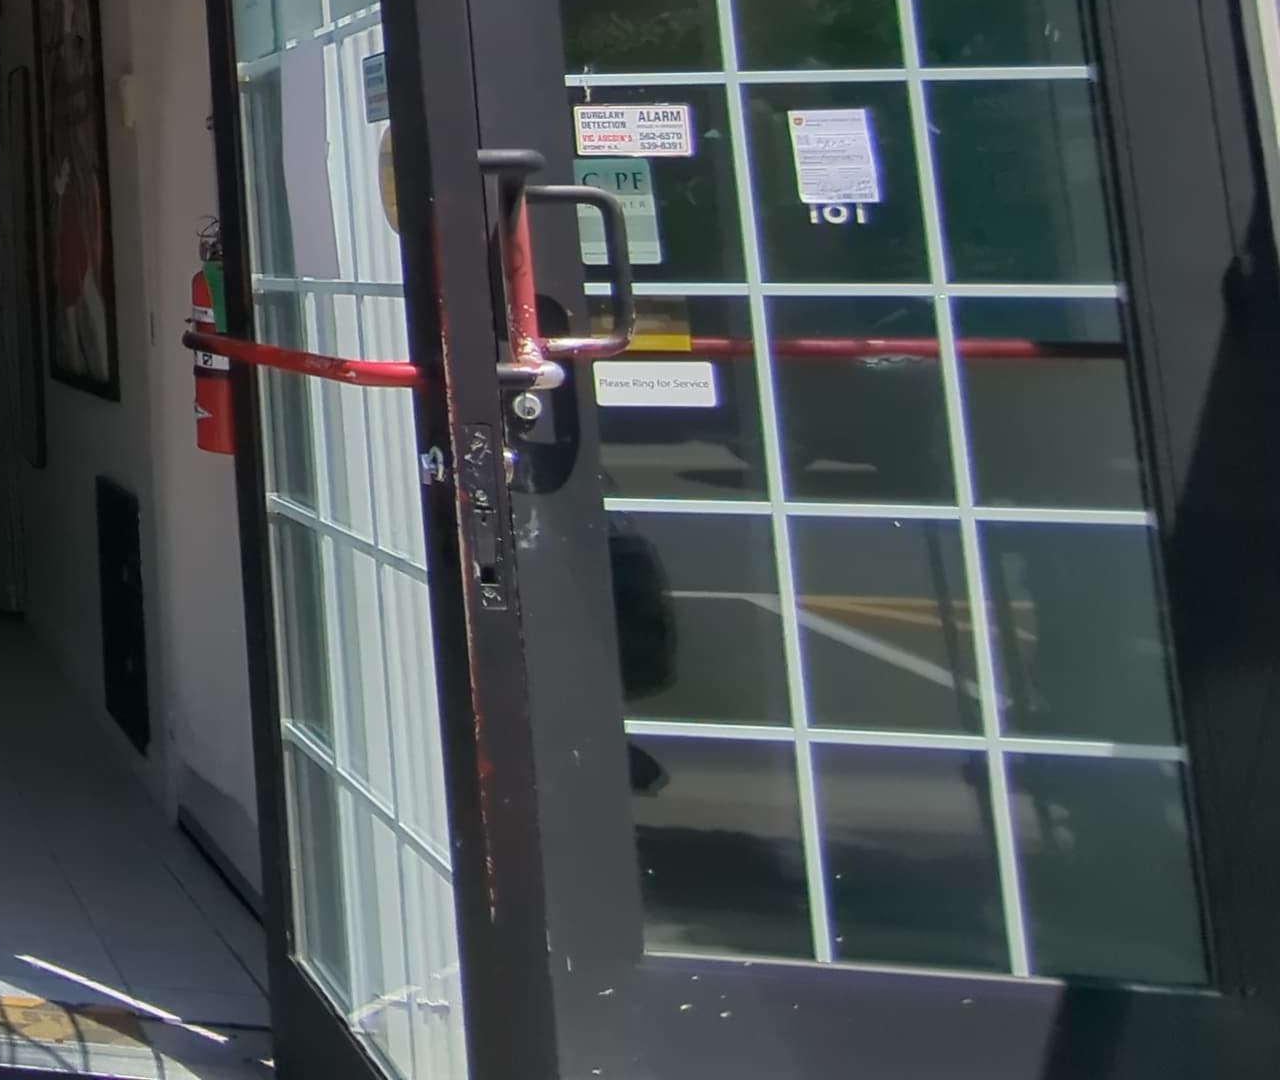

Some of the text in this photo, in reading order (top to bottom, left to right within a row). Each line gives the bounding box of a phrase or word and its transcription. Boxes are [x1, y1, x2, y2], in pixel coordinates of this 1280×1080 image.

[638, 110, 681, 122] ALARM
[581, 121, 627, 129] DETECTION
[599, 378, 710, 390] Please Ring for Service
